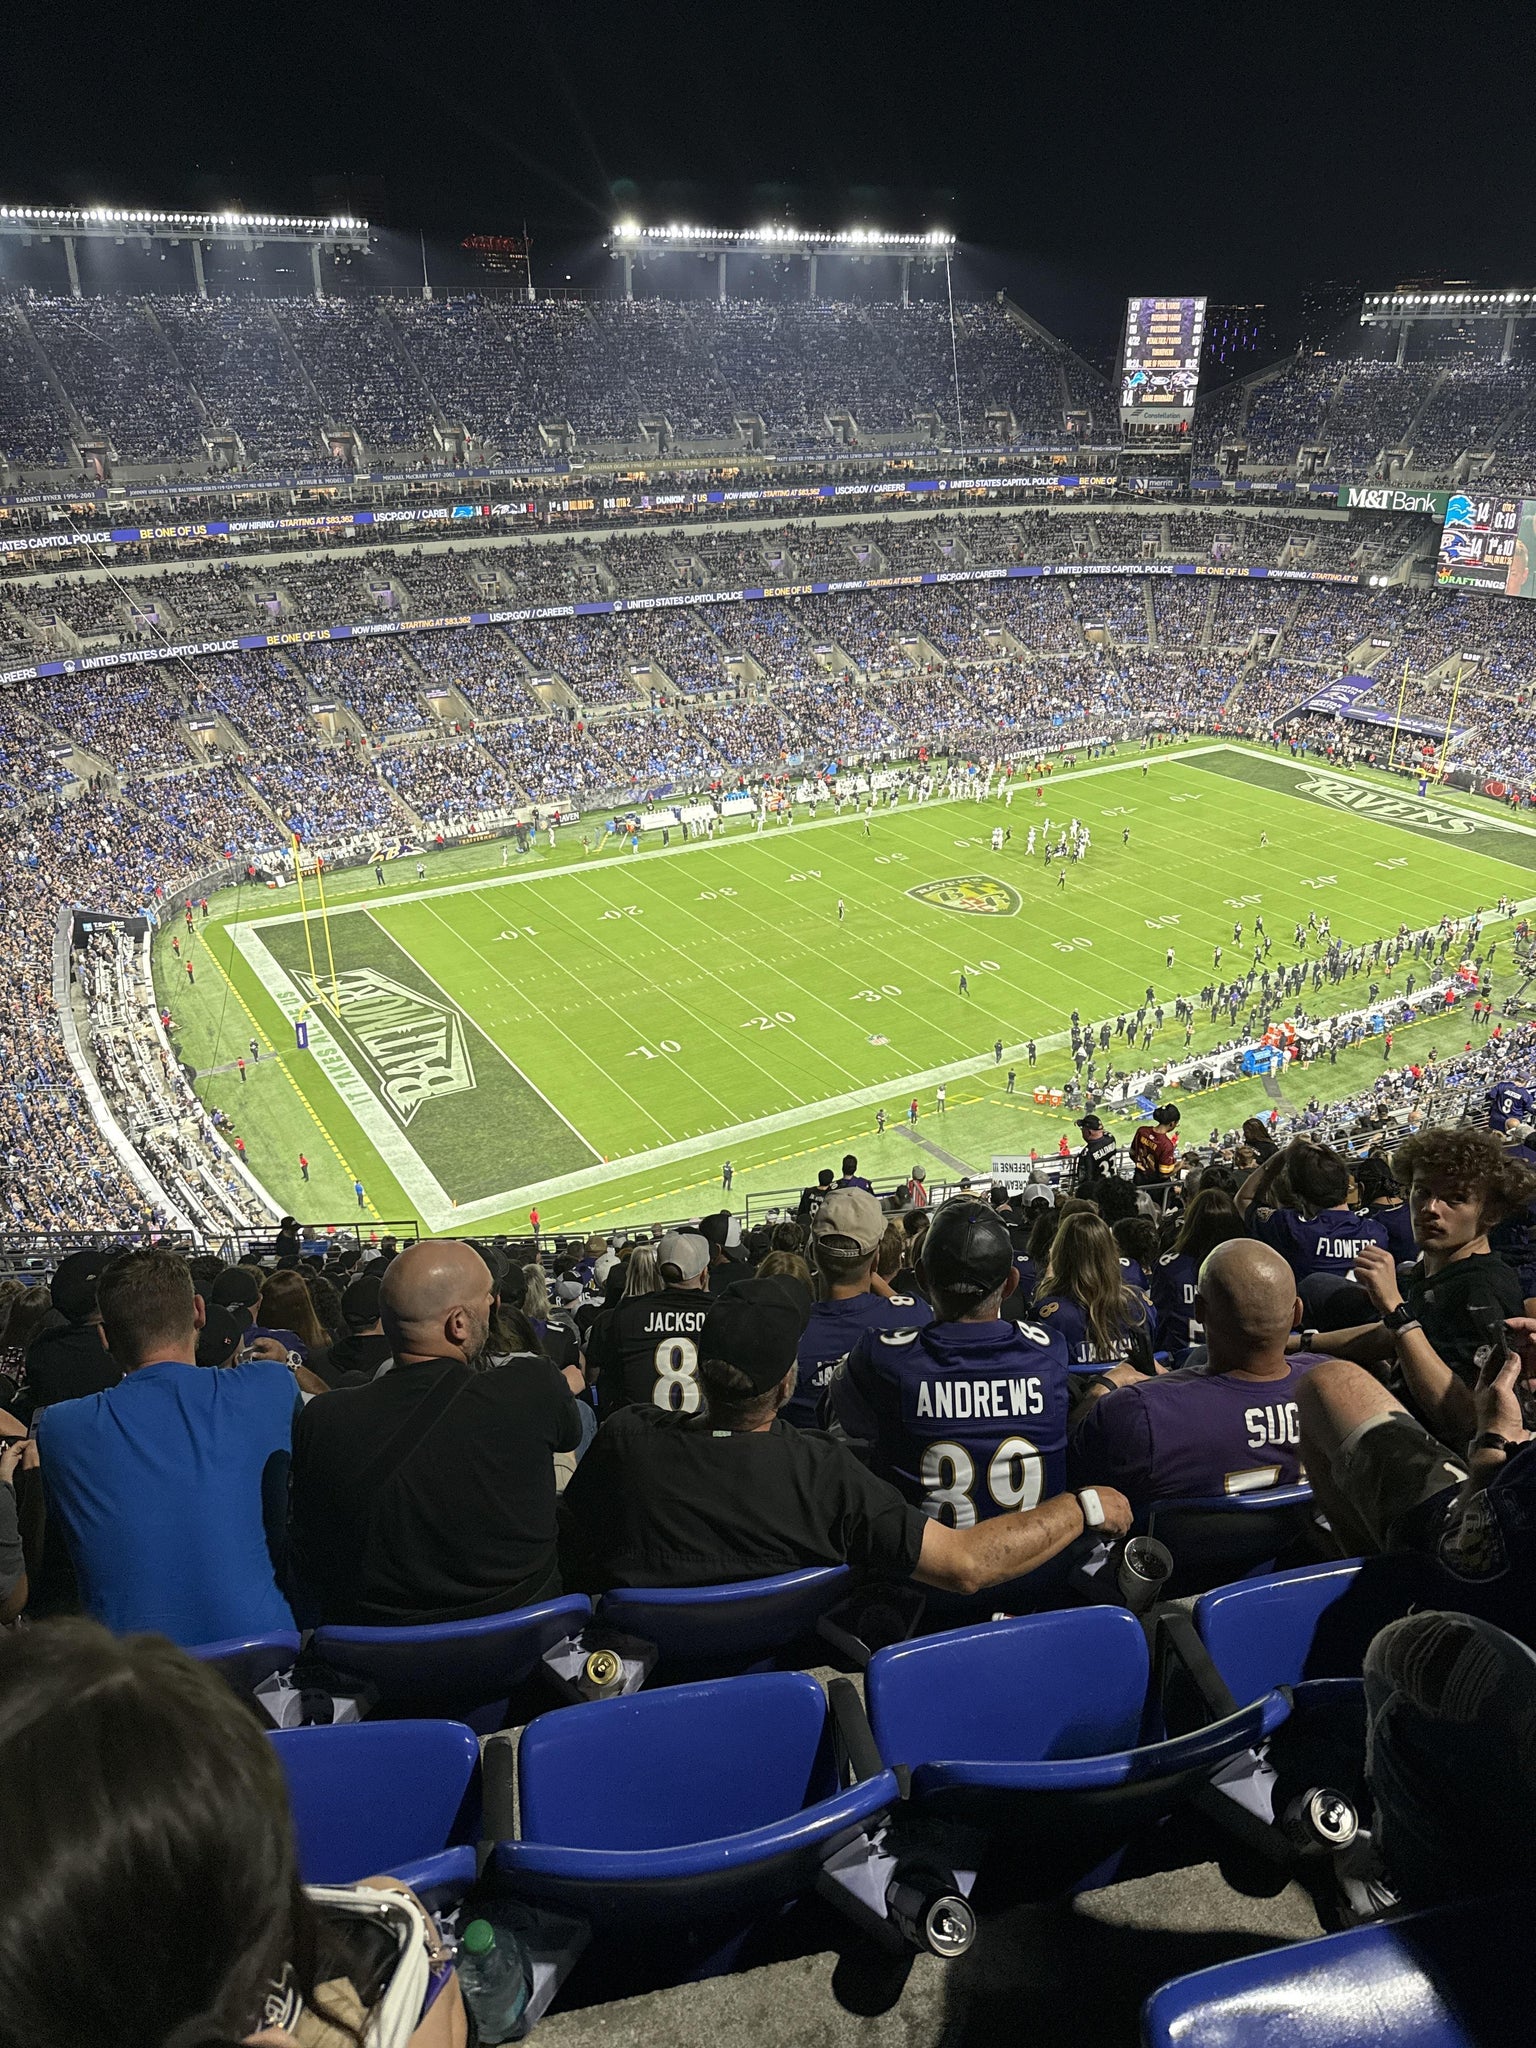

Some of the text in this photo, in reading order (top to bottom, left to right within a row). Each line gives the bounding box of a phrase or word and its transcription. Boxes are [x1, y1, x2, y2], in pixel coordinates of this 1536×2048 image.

[1122, 390, 1133, 406] 14
[1183, 390, 1194, 406] 14
[835, 483, 905, 495] USCP.GOV CAREERS
[950, 477, 1059, 489] UNITED STATES CAPITOL POLICE
[1090, 477, 1106, 485] ONE
[1106, 477, 1117, 485] OF
[1148, 479, 1174, 487] merritt
[16, 495, 41, 504] EARNEST
[63, 492, 95, 500] 1996-2003
[697, 494, 708, 502] US
[724, 492, 738, 500] NOW
[738, 491, 759, 499] HIRING
[763, 489, 790, 498] STARTING
[1347, 488, 1437, 512] M&T Bank
[373, 511, 416, 522] USCP.GOV
[1477, 502, 1489, 522] 14
[229, 522, 248, 532] NOW
[249, 520, 274, 530] HIRING
[280, 517, 315, 528] STARTING
[315, 516, 325, 525] AT
[1494, 512, 1516, 530] 0:18
[29, 532, 111, 548] CAPITOL POLICE
[140, 525, 207, 539] BE ONE OF US
[1471, 538, 1482, 560] 14
[1503, 539, 1514, 557] 10
[937, 569, 1007, 582] USCP.GOV CAREERS
[1055, 565, 1173, 574] UNITED STATES CAPITOL POLICE
[1196, 566, 1249, 576] BE ONE OF US
[1267, 569, 1350, 582] NOW HIRING STARTING AT
[828, 582, 842, 590] NOW
[843, 581, 862, 589] HIRING
[866, 578, 893, 587] STARTING
[892, 577, 900, 585] AT
[1438, 574, 1505, 590] DRAFTKINGS
[764, 585, 812, 597] BE ONE OF US
[627, 591, 743, 610] UNITED STATES CAPITOL POLICE
[489, 605, 574, 622] USCP.GOV CAREERS
[351, 624, 369, 635] NOW
[371, 622, 395, 633] HIRING
[400, 618, 434, 630] STARTING
[434, 617, 444, 626] AT
[266, 629, 330, 645] BE ONE OF US
[81, 639, 239, 669] UNITED STATES CAPITOL POLICE
[1305, 774, 1474, 834] RAVENS
[1373, 857, 1405, 871] 10
[789, 868, 823, 884] 40
[1300, 874, 1335, 890] 20
[915, 877, 982, 894] RAVENS
[700, 887, 738, 901] 30
[1223, 894, 1259, 909] 30
[605, 904, 644, 921] 20
[1145, 914, 1178, 931] 40
[500, 924, 540, 941] 10
[1051, 937, 1093, 953] 50
[962, 959, 1004, 978] 40
[276, 991, 301, 1006] US
[858, 984, 903, 1003] 30
[750, 1011, 797, 1031] 20
[635, 1039, 682, 1060] 10
[316, 1047, 361, 1089] TAKES
[1000, 1163, 1030, 1173] DEFENSE
[889, 1295, 915, 1306] 8
[1039, 1302, 1060, 1318] 8
[653, 1337, 700, 1413] 8
[917, 1377, 1044, 1418] ANDREWS
[920, 1436, 1044, 1530] 89
